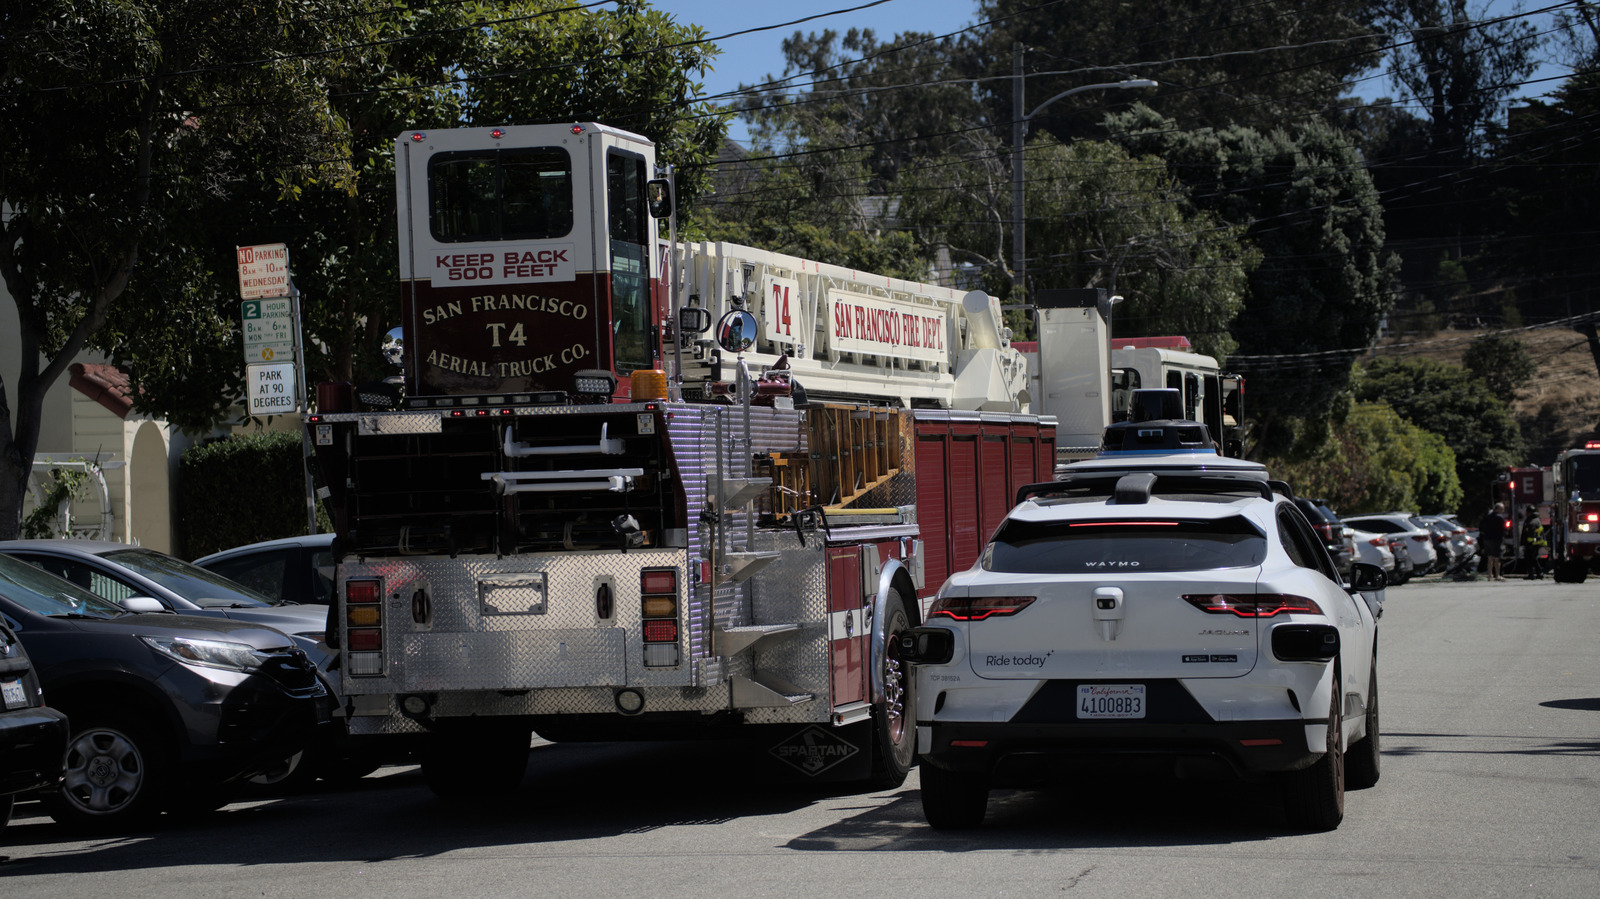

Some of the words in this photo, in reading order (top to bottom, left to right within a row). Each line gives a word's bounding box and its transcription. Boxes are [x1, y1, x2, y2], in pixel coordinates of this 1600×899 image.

[239, 249, 253, 264] NO
[255, 249, 284, 260] PARKING
[436, 253, 495, 268] KEEP
[504, 250, 568, 264] BACK
[448, 267, 493, 281] 500
[503, 264, 558, 278] FEET
[243, 276, 285, 288] WEDNESDAY
[246, 303, 257, 317] 2
[423, 300, 463, 325] SAN
[471, 294, 587, 320] FRANCISCO
[772, 283, 792, 336] T4
[835, 302, 853, 338] SAN
[854, 305, 900, 346] FRANCISCO
[902, 313, 921, 348] FIRE
[922, 316, 943, 350] DEPT.
[486, 322, 528, 348] T4
[426, 349, 491, 377] AERIAL
[498, 354, 557, 378] TRUCK
[561, 343, 590, 364] CO.
[260, 370, 282, 380] PARK
[260, 384, 269, 394] AT
[272, 384, 284, 393] 90
[254, 396, 292, 408] DEGREES
[1522, 477, 1534, 494] E
[986, 655, 1010, 666] Ride
[1013, 655, 1047, 668] today
[1091, 687, 1133, 697] California
[1081, 697, 1140, 713] 41008B3
[779, 745, 848, 756] SPARTAN
